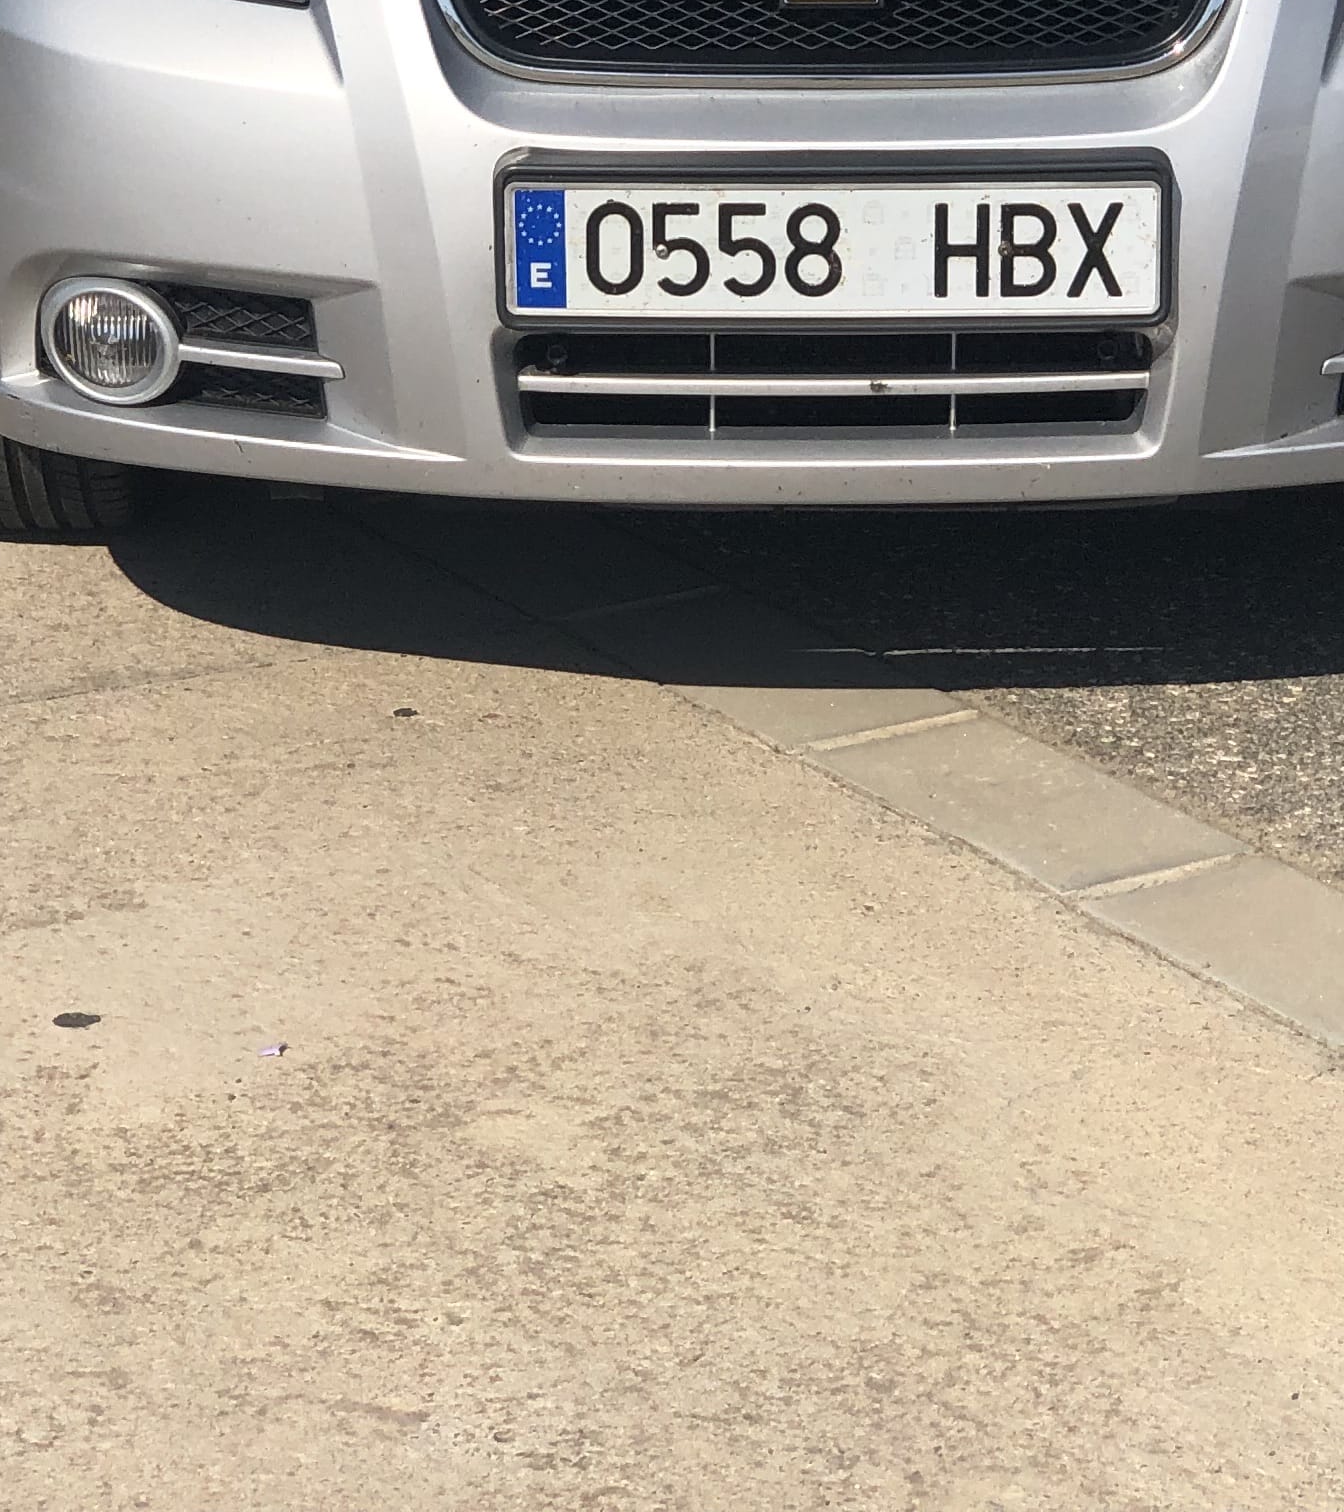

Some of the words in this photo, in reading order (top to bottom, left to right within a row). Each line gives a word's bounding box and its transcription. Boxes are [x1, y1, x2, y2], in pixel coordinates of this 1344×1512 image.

[530, 262, 552, 288] E
[585, 200, 843, 297] 0558
[934, 202, 1124, 298] HBX
